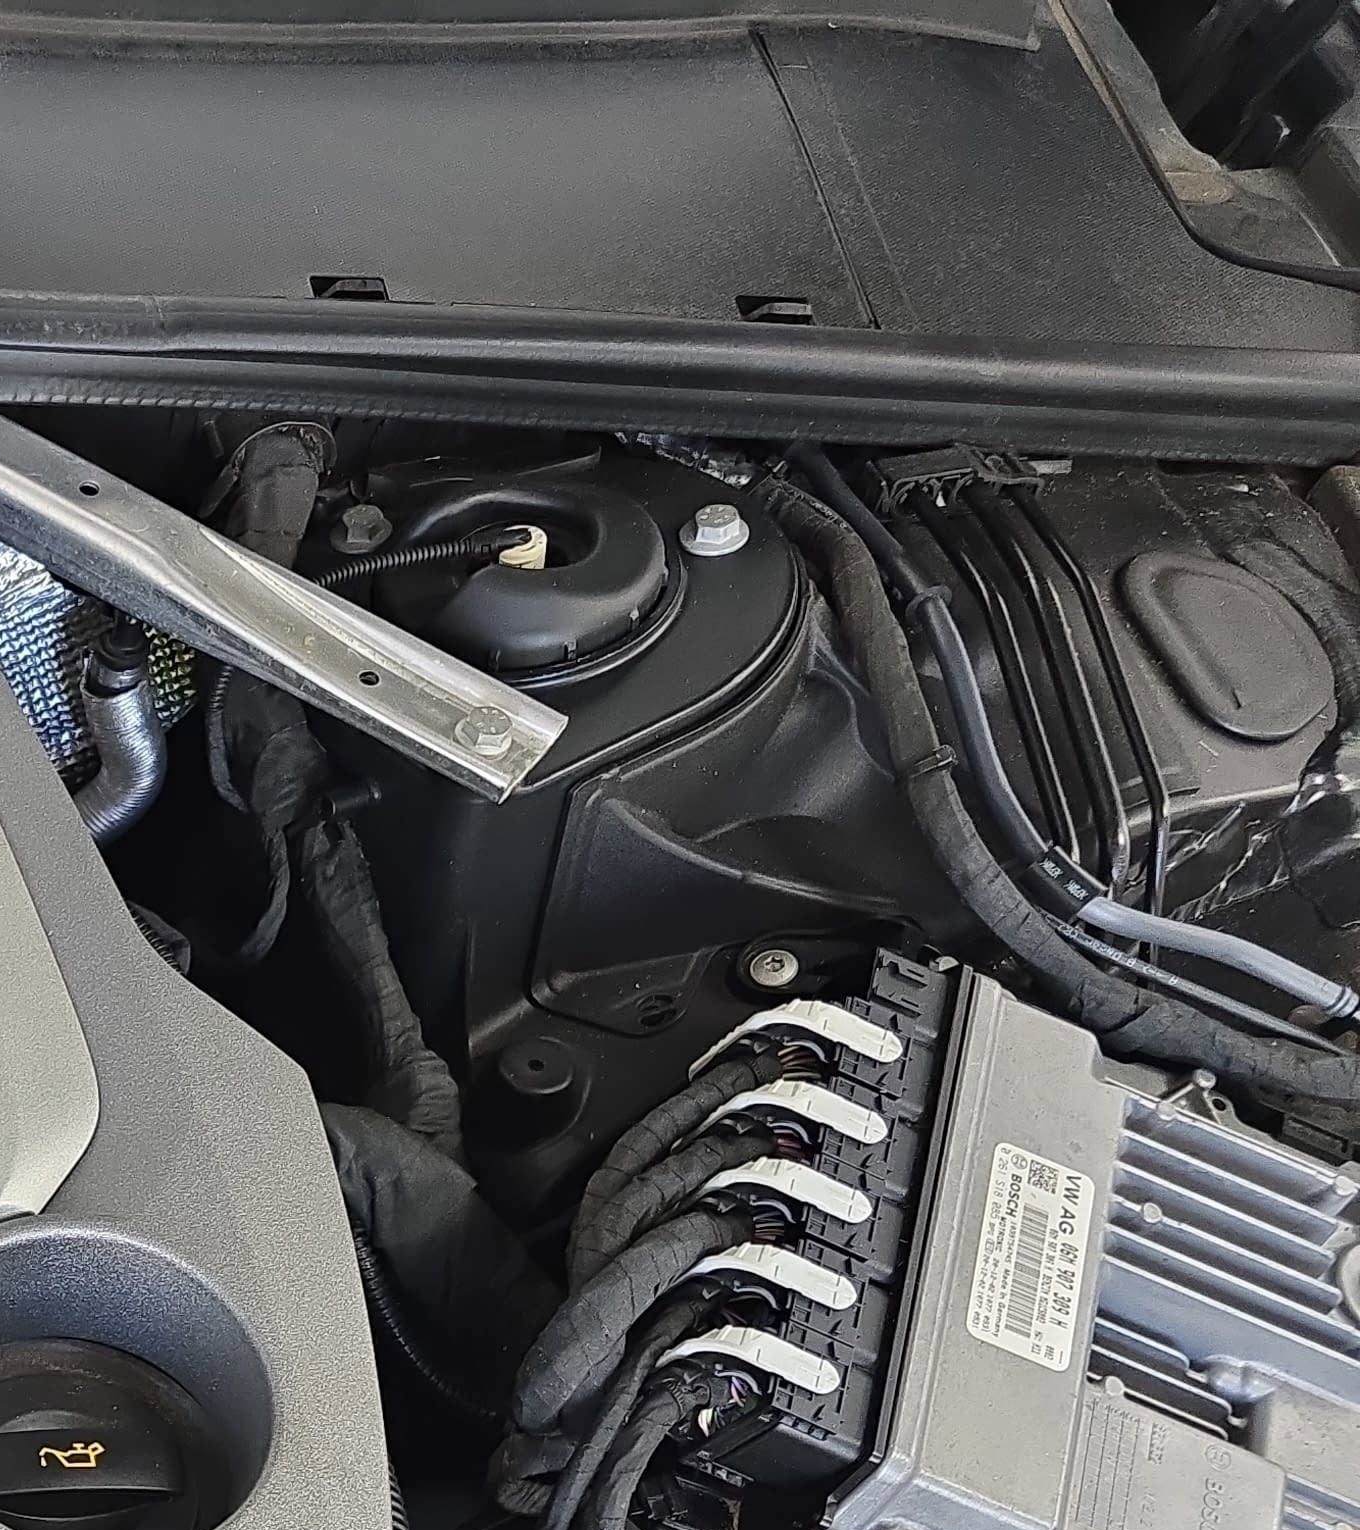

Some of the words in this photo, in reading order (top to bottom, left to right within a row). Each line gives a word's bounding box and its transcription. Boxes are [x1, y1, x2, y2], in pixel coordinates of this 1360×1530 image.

[996, 1155, 1009, 1177] 261
[1004, 1172, 1022, 1218] BOSCH
[1063, 1175, 1080, 1203] VW
[1057, 1205, 1074, 1236] AG
[1000, 1267, 1011, 1291] Made
[1055, 1267, 1075, 1290] 907
[999, 1291, 1008, 1301] in
[1051, 1291, 1071, 1315] 309
[990, 1301, 1006, 1338] Germany
